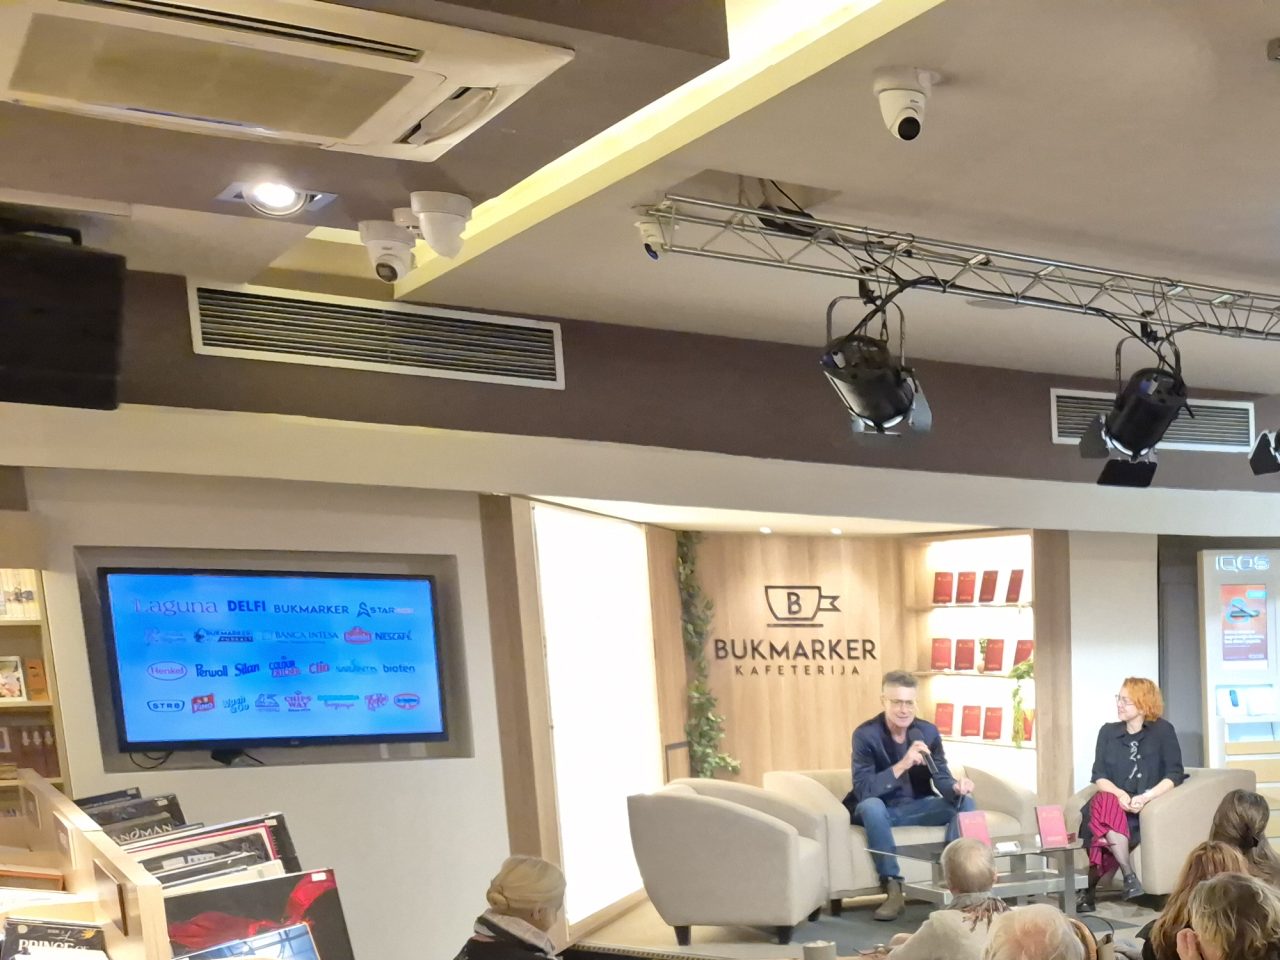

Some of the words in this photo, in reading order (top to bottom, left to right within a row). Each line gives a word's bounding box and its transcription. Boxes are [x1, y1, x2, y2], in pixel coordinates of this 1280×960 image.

[1215, 555, 1270, 572] IQOS
[134, 598, 218, 616] Laguna
[227, 600, 266, 612] DELFI
[273, 604, 350, 614] BUKMARKER
[786, 591, 802, 615] B
[714, 639, 877, 660] BUKMARKER
[195, 663, 228, 677] Perwoll
[735, 665, 860, 675] KAFETERIJA
[112, 823, 173, 845] ANDMAN
